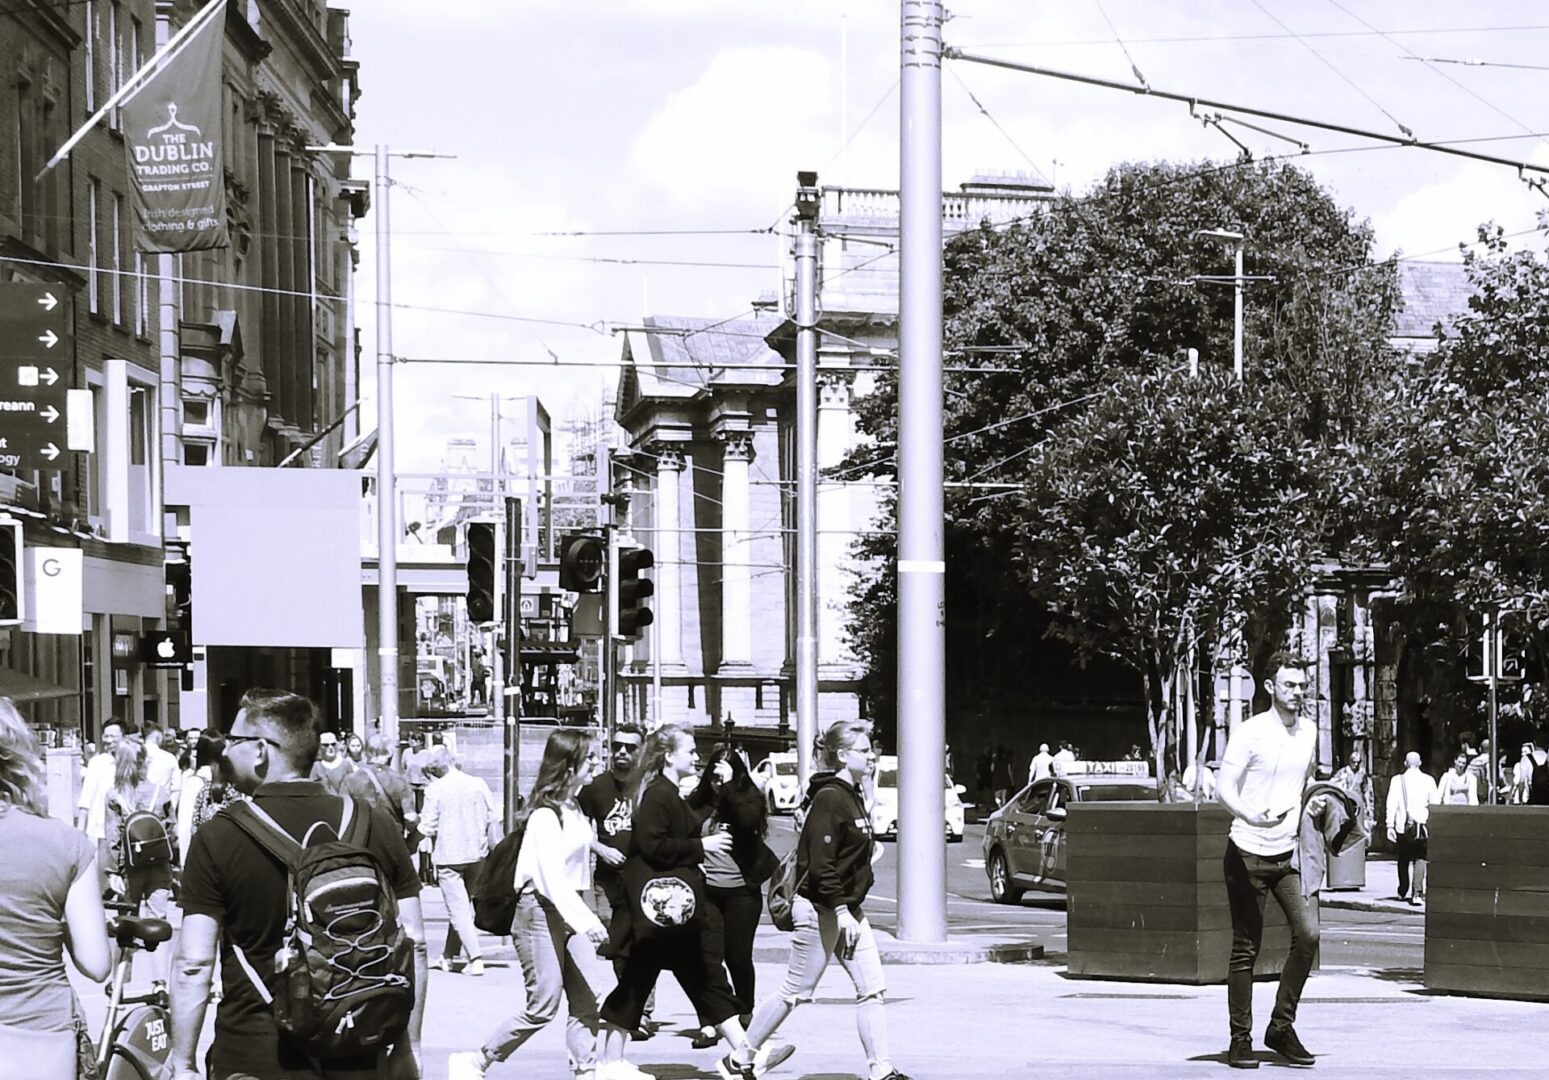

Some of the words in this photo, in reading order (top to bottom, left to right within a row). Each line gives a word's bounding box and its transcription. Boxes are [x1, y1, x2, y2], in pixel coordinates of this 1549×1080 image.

[162, 134, 186, 144] THE
[134, 142, 214, 162] DUBLIN
[136, 163, 189, 175] TRADING
[192, 162, 213, 172] CO.
[142, 183, 180, 192] GRAFTON
[182, 181, 210, 190] STREET
[187, 219, 195, 230] &
[197, 217, 218, 230] gifts
[1087, 761, 1116, 773] TAXI
[145, 1019, 165, 1039] JUST
[152, 1033, 168, 1052] EAT
